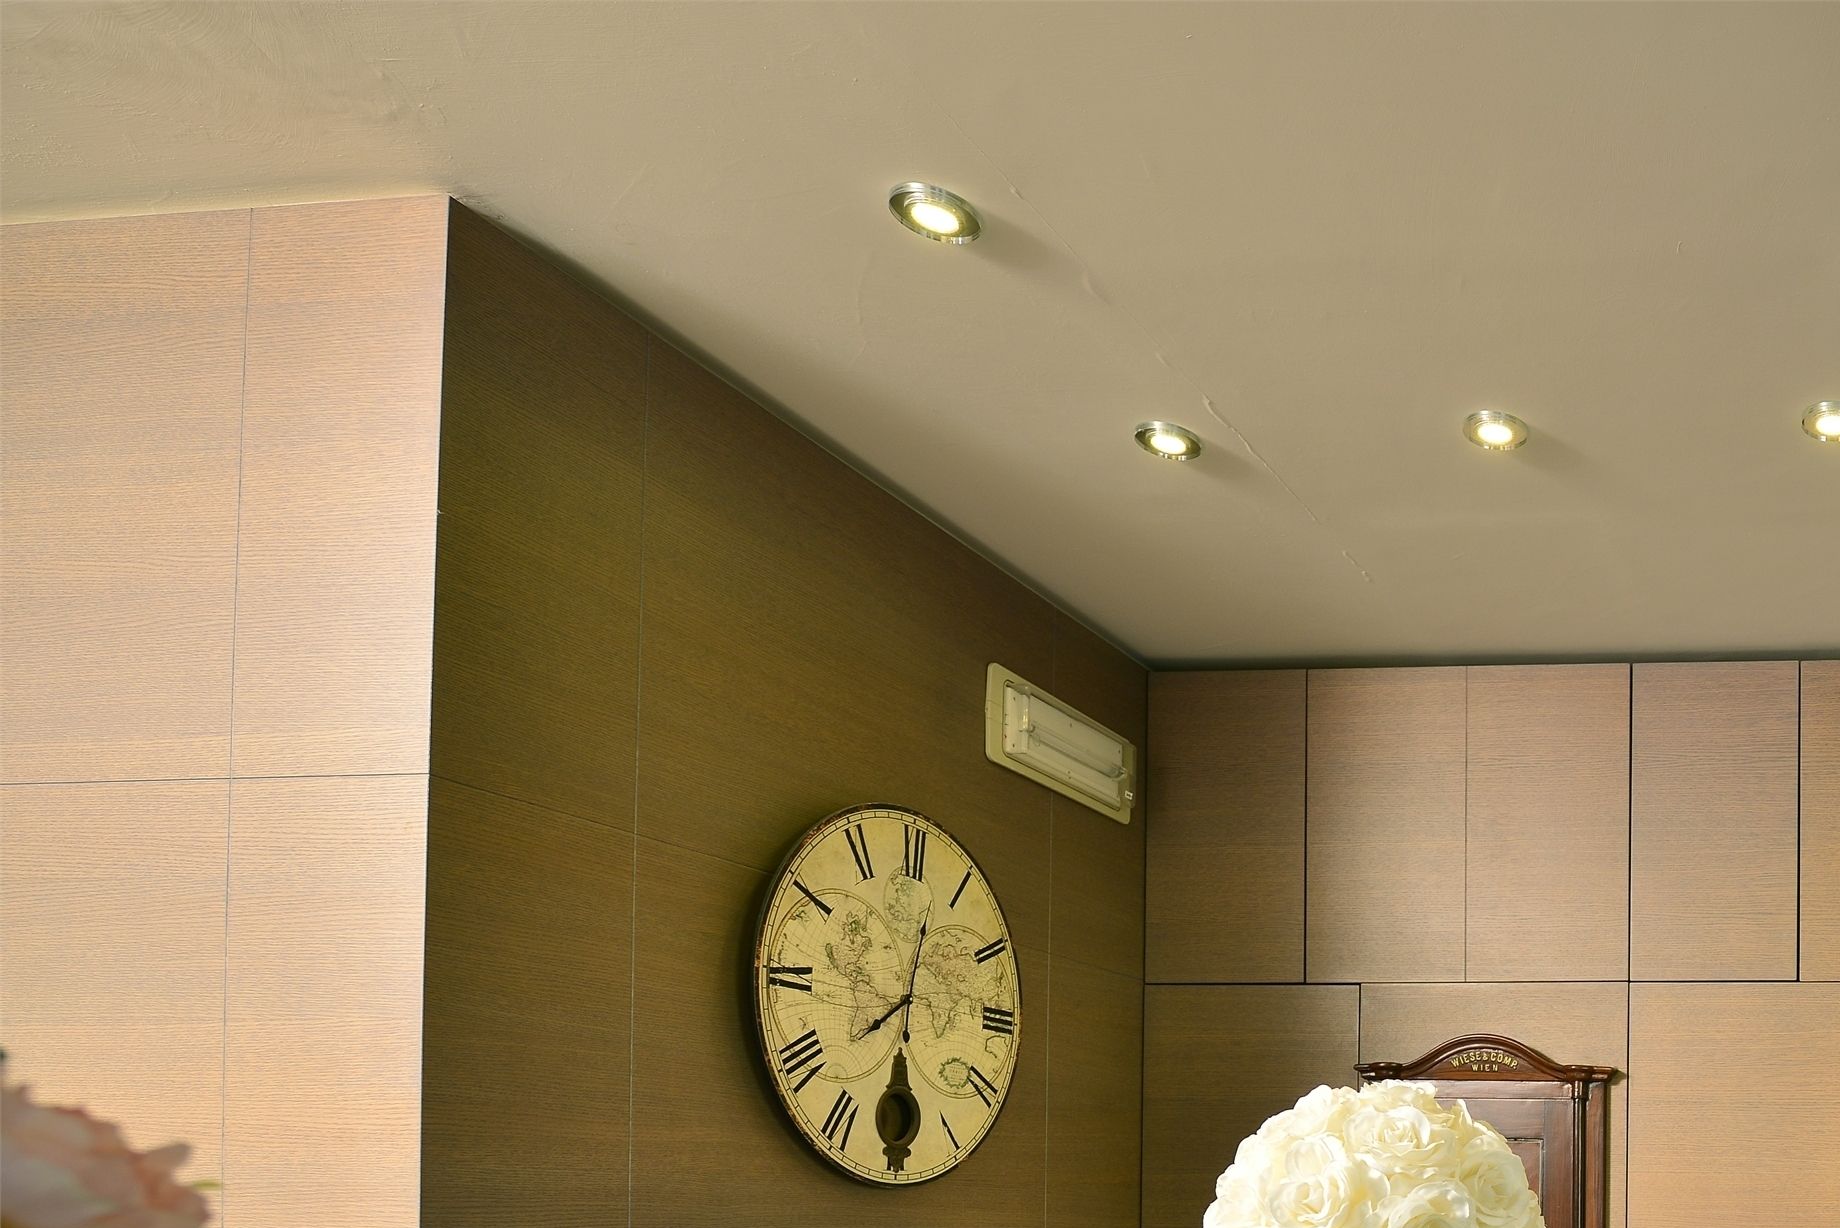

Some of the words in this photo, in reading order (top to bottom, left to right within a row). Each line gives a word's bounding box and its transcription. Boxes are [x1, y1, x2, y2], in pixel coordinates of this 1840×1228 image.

[899, 823, 929, 884] XII
[982, 1002, 1014, 1036] III
[1450, 1051, 1481, 1068] WIESE
[1471, 1064, 1499, 1072] WIEN
